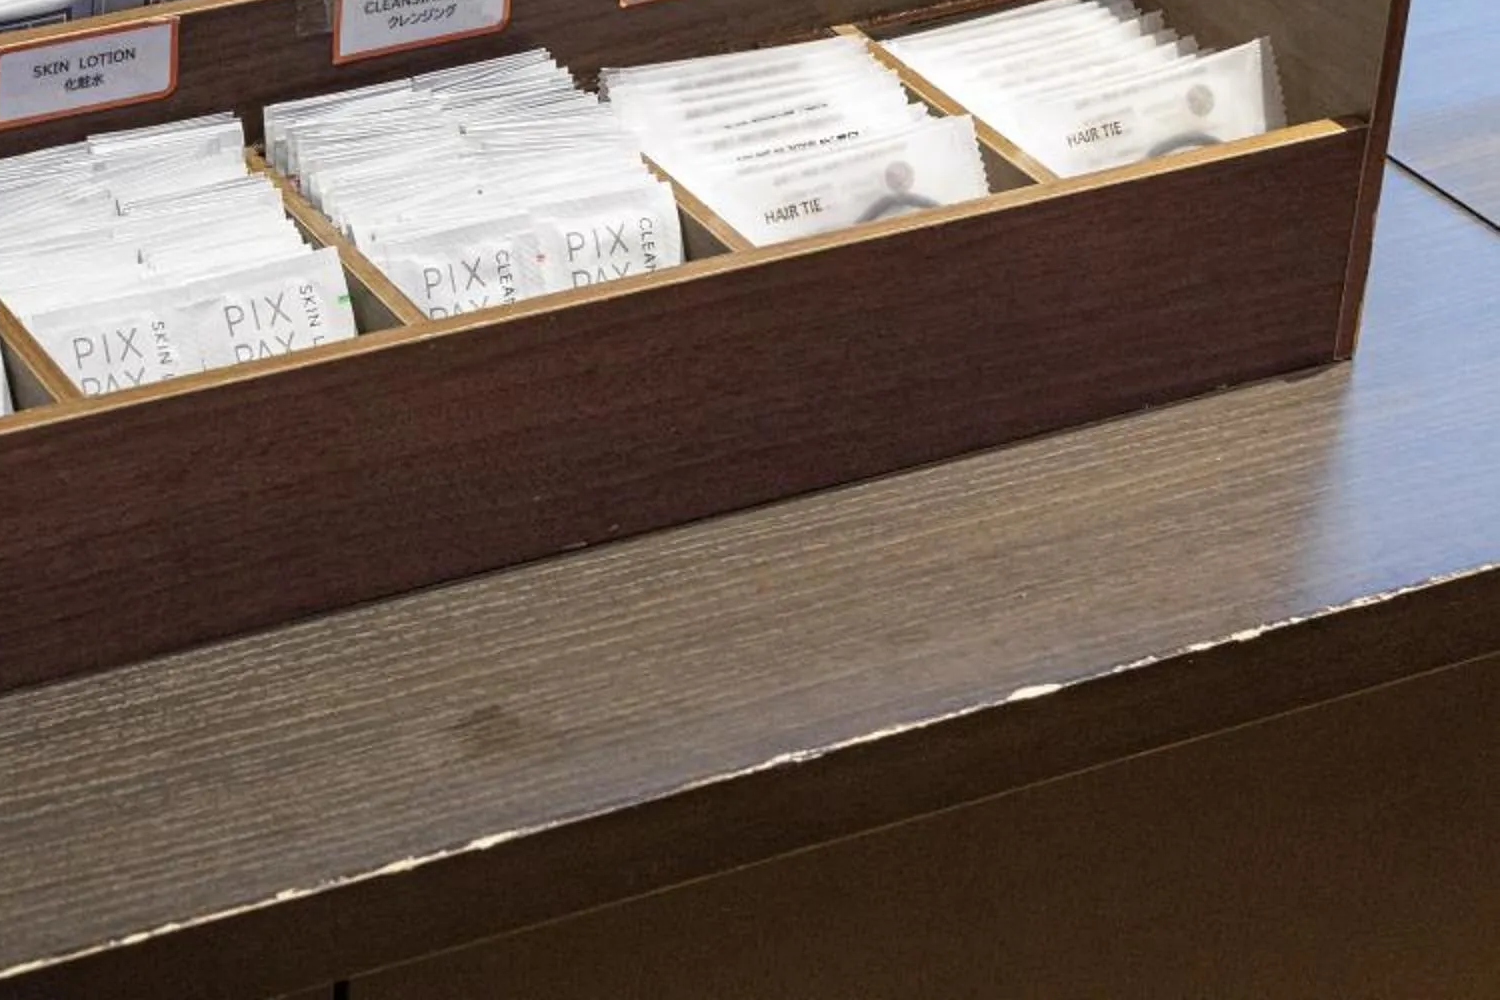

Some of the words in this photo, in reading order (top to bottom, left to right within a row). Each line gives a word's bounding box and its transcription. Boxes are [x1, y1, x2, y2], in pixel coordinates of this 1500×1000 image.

[387, 3, 457, 29] クレンジング
[33, 60, 70, 79] SKIN
[79, 48, 136, 70] LOTION
[64, 74, 104, 92] 化粧水
[1066, 127, 1100, 148] HAIR
[1102, 121, 1123, 137] TIE
[764, 201, 800, 225] HAIR
[800, 198, 824, 216] TIE
[566, 223, 630, 262] PIX
[423, 256, 486, 300] PIX
[224, 292, 293, 338] PIX
[299, 284, 322, 328] SKIN
[73, 327, 144, 369] PIX
[151, 321, 173, 365] SKIN
